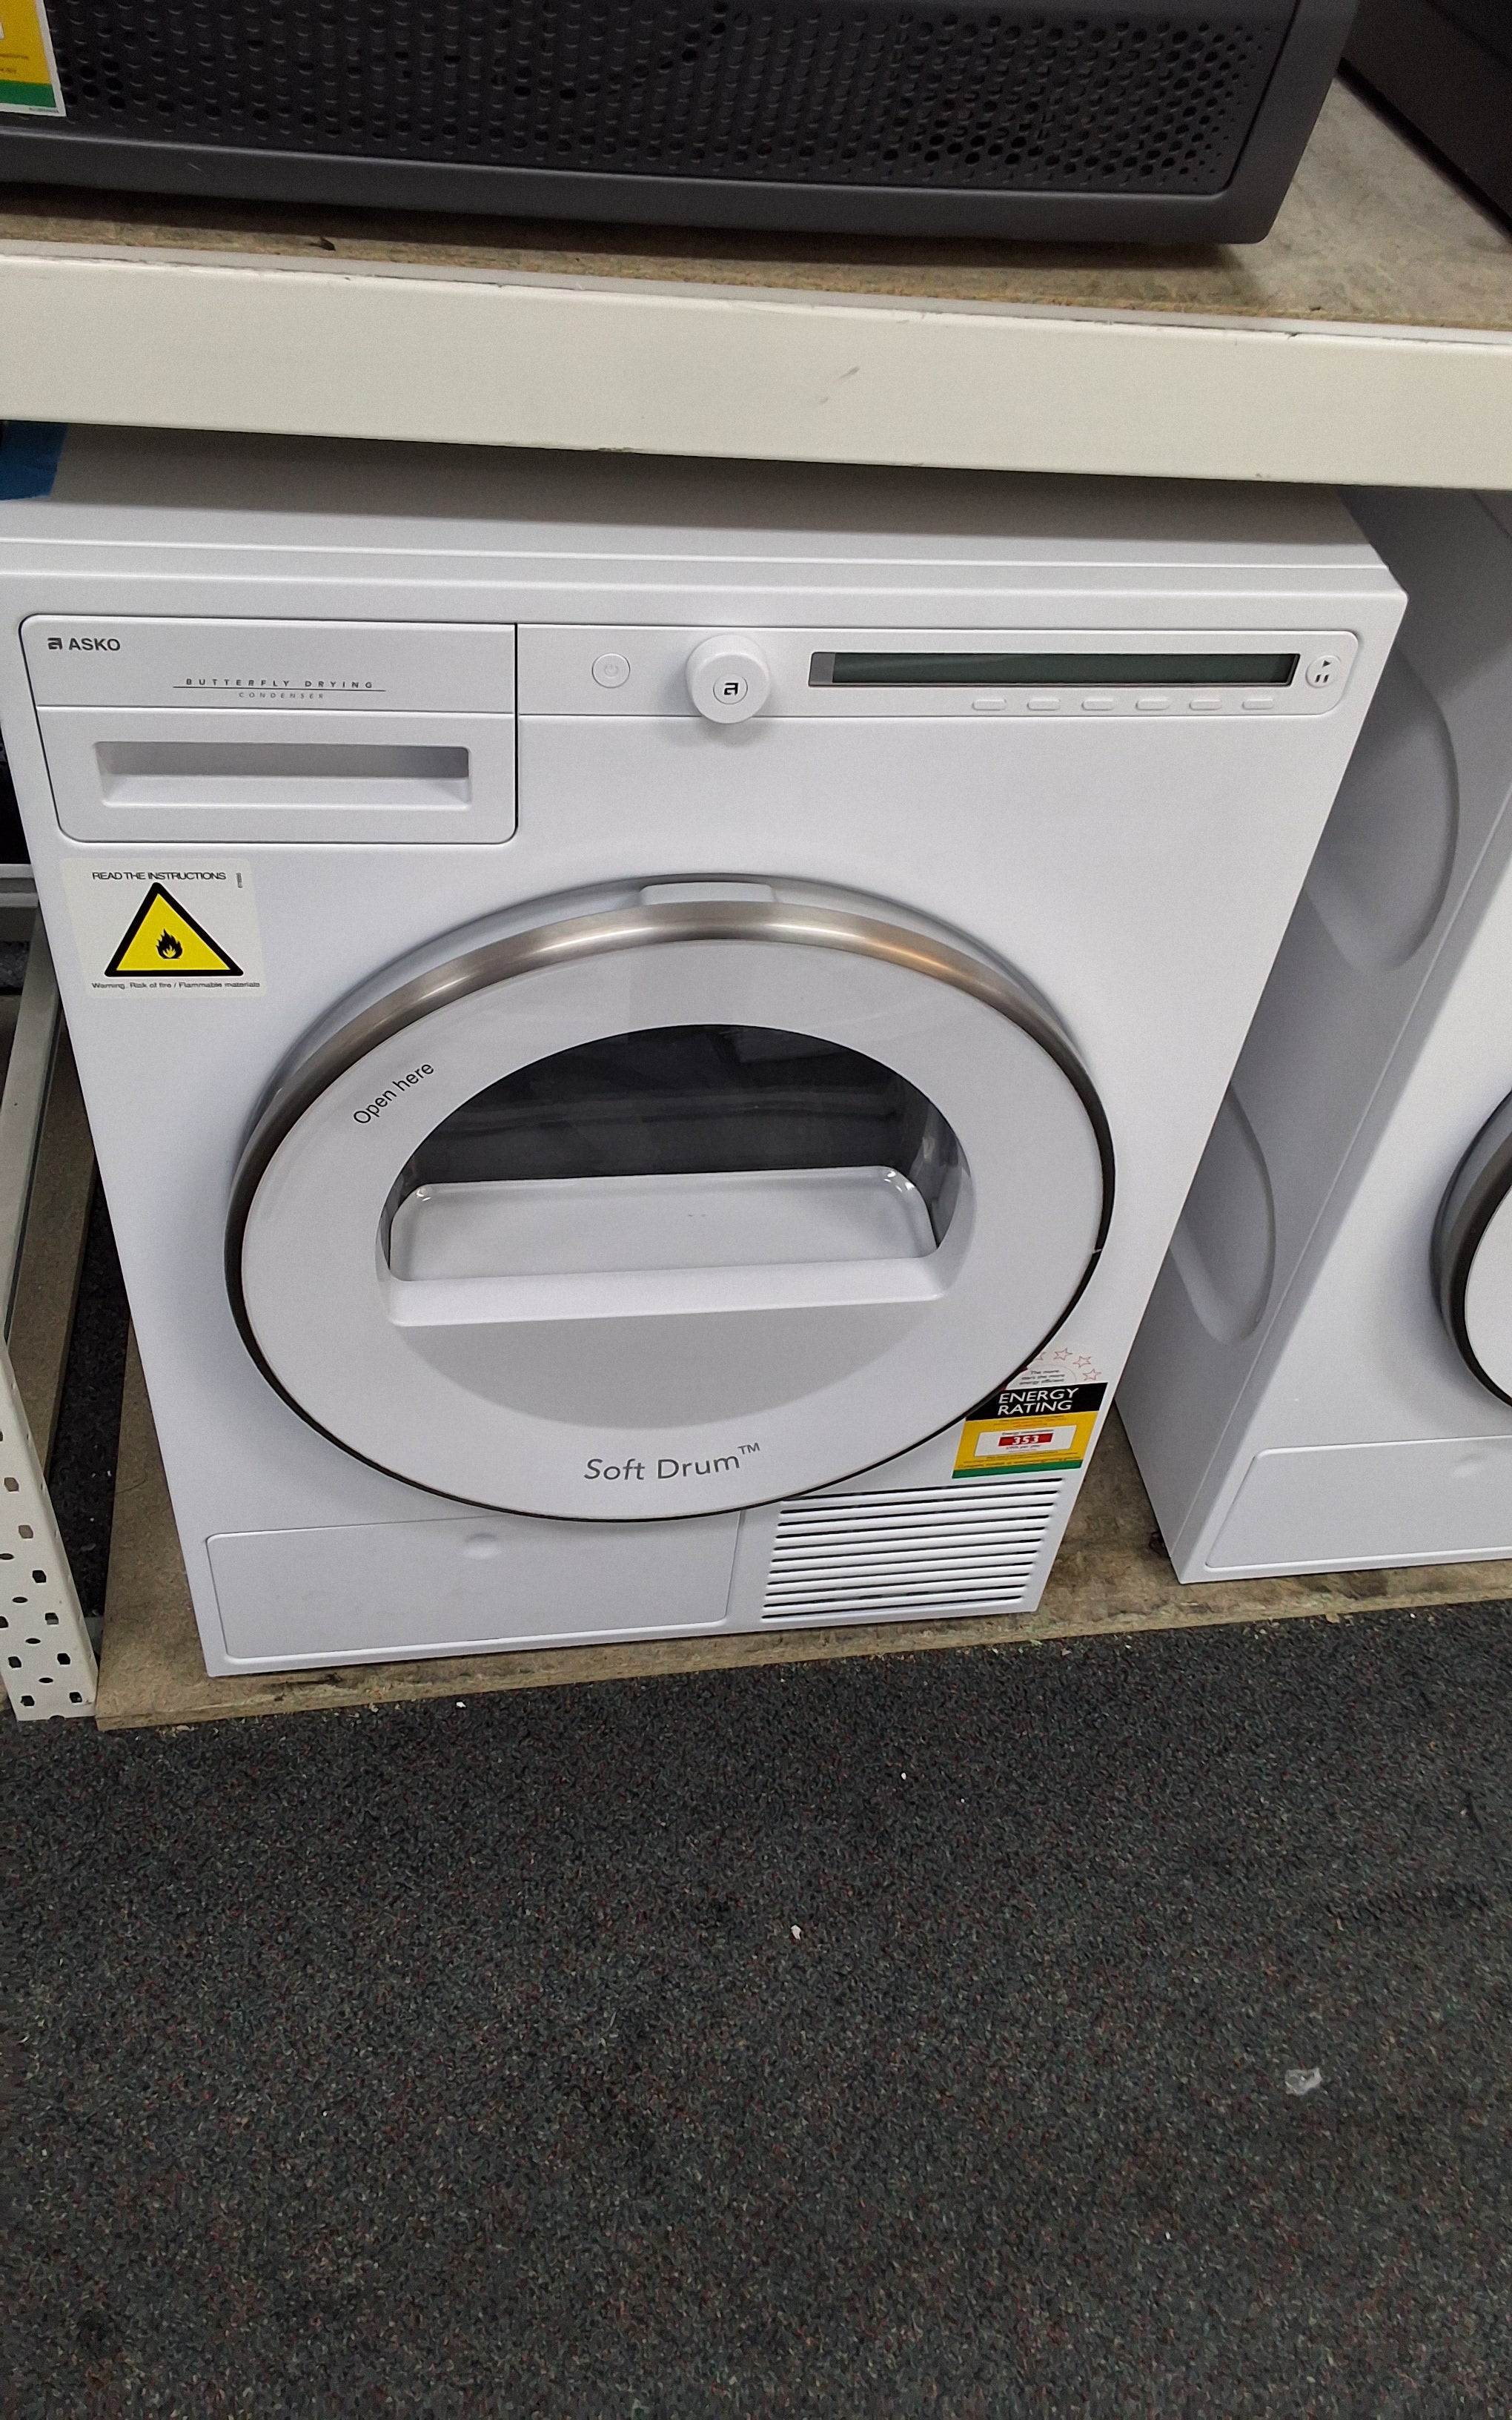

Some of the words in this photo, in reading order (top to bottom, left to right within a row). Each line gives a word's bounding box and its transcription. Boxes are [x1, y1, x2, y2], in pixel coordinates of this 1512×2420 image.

[68, 638, 121, 651] ASKO
[186, 678, 290, 687] BUTTERFLY
[305, 680, 373, 689] DRYING
[92, 872, 122, 880] READ
[123, 872, 146, 880] THE
[147, 872, 227, 880] INSTRUCTIONS
[353, 1090, 397, 1124] Open
[391, 1063, 434, 1091] here
[998, 1387, 1079, 1404] ENERGY
[998, 1400, 1073, 1416] RATING
[1012, 1435, 1040, 1445] 353
[583, 1458, 646, 1481] Soft
